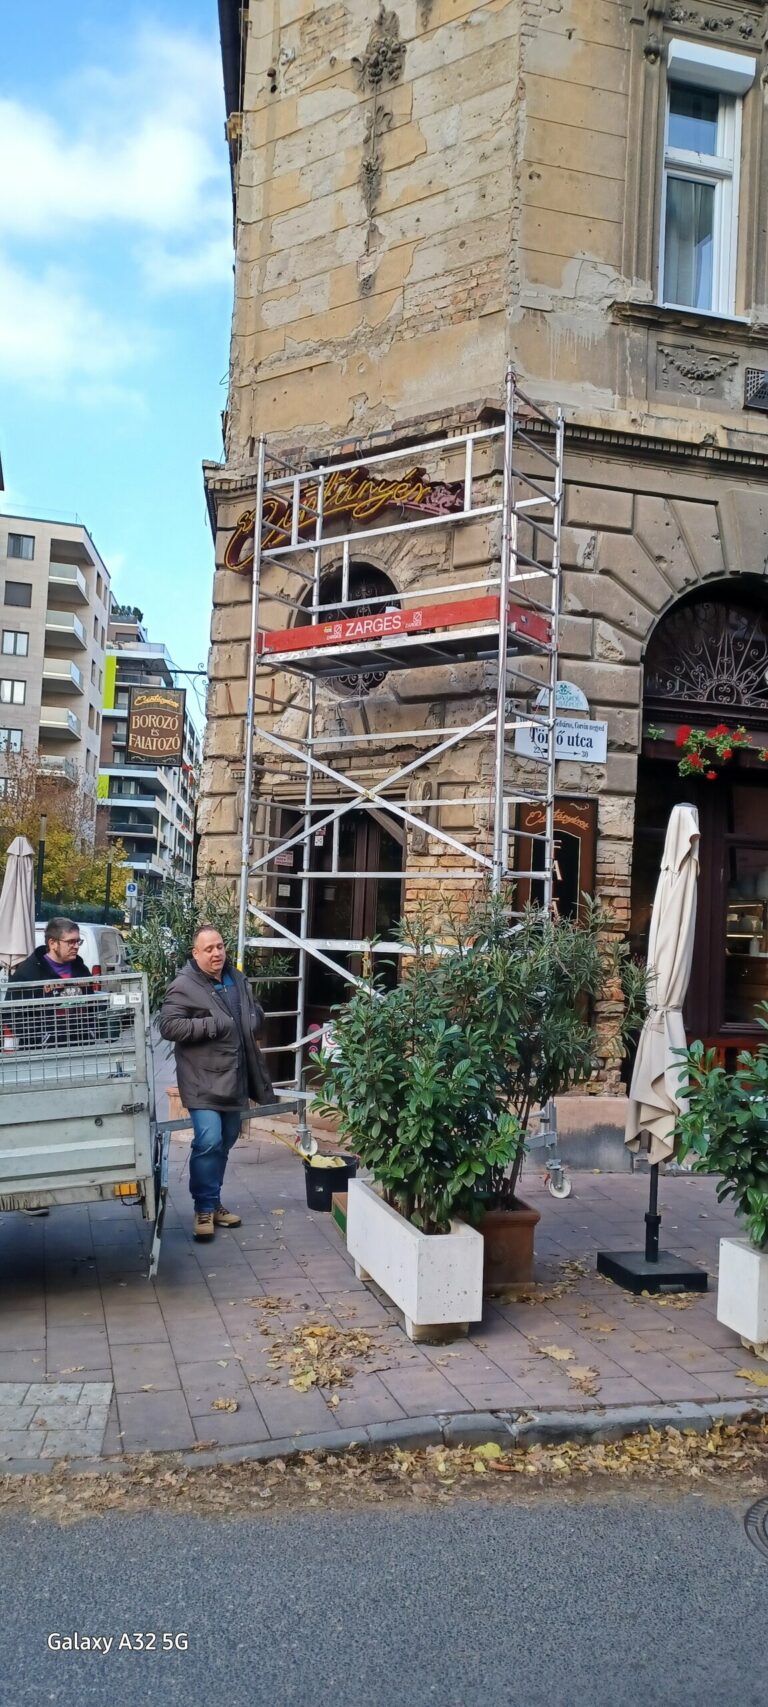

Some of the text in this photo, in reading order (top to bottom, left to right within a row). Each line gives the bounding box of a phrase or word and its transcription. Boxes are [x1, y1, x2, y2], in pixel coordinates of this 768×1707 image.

[345, 615, 402, 637] ZARGES
[132, 714, 179, 731] BOROZÓ
[128, 733, 180, 751] FALATOZÓ
[567, 731, 594, 749] utca
